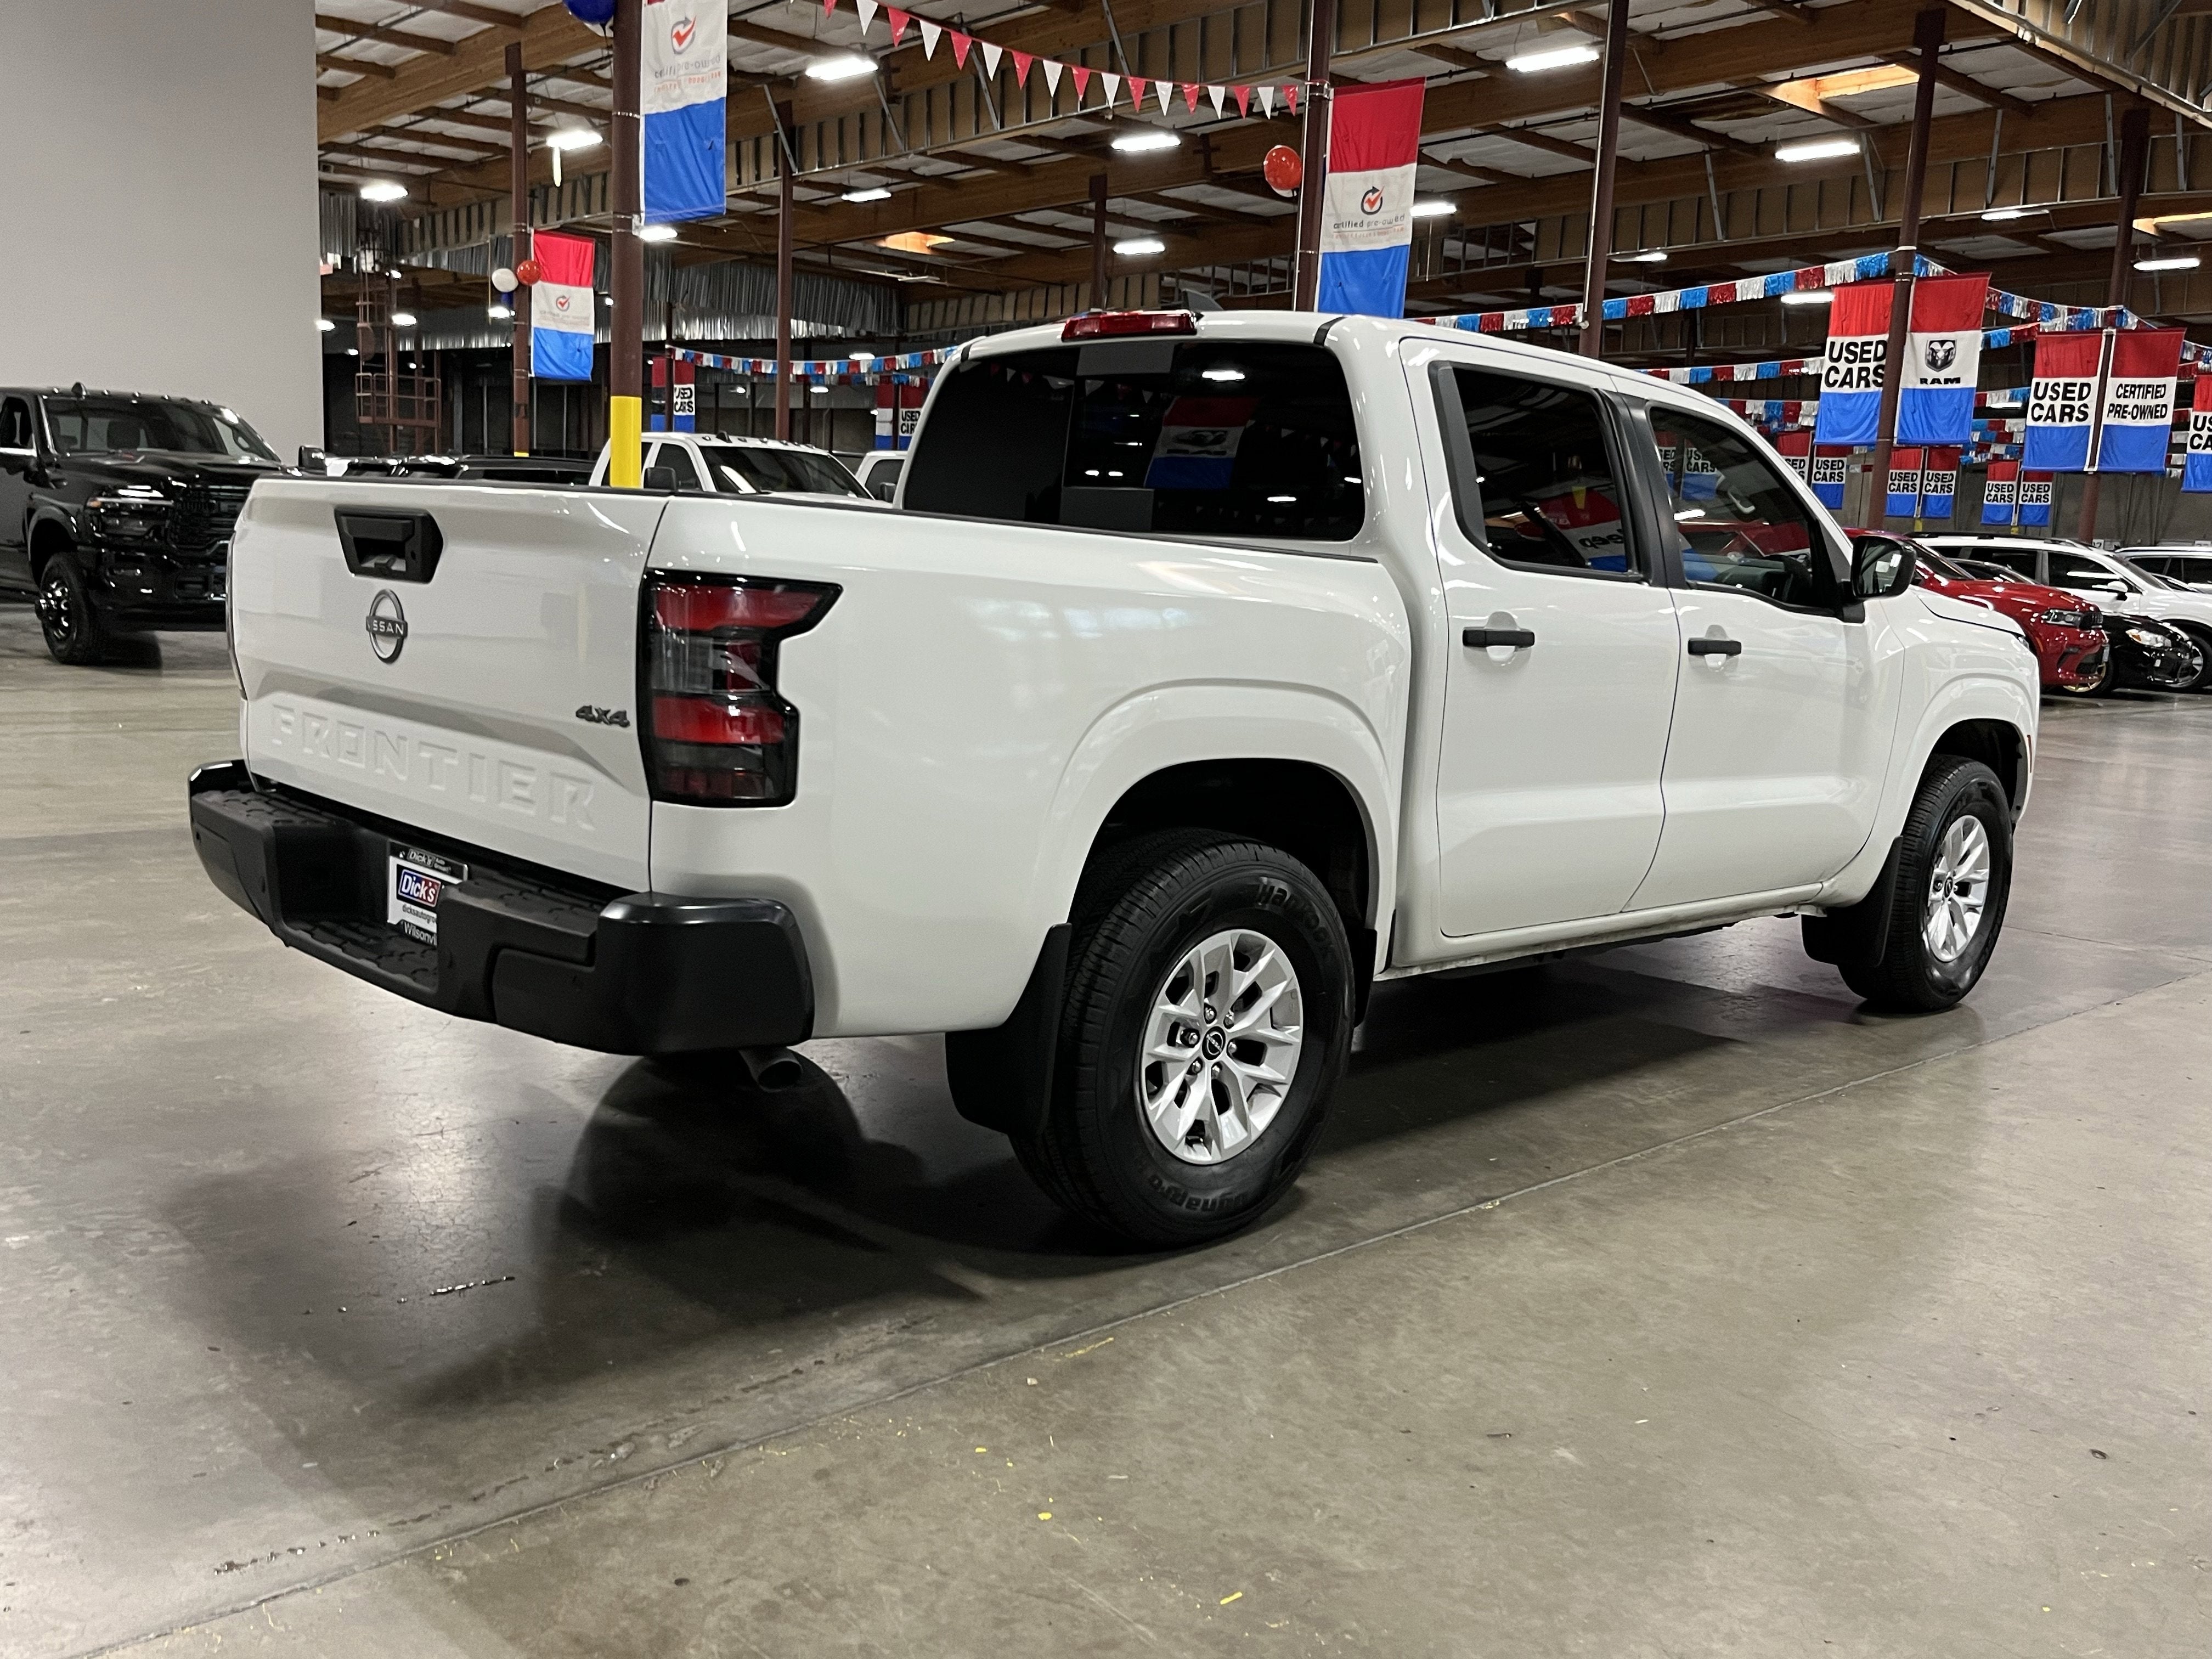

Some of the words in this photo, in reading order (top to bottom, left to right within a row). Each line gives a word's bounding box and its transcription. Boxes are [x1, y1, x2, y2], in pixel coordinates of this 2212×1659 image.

[1829, 340, 1888, 364] USED
[1824, 364, 1885, 388] CARS
[2033, 381, 2091, 402] USED
[2115, 383, 2167, 399] CERTIFIED
[901, 410, 921, 422] USED
[2031, 403, 2089, 423] CARS
[2107, 403, 2168, 420] PRE-OWNED
[1785, 459, 1805, 470] SED
[1815, 459, 1845, 470] USED
[1814, 471, 1844, 482] CARS
[1890, 472, 1918, 482] USED
[1926, 472, 1954, 483] USED
[1888, 482, 1917, 493] CARS
[1925, 483, 1953, 494] CARS
[1987, 483, 2014, 493] USED
[2022, 483, 2051, 493] USED
[1986, 493, 2013, 503] CARS
[2021, 494, 2050, 503] CARS
[366, 618, 404, 635] SSAN
[273, 703, 597, 832] FRONTIER
[401, 874, 436, 902] Dick's
